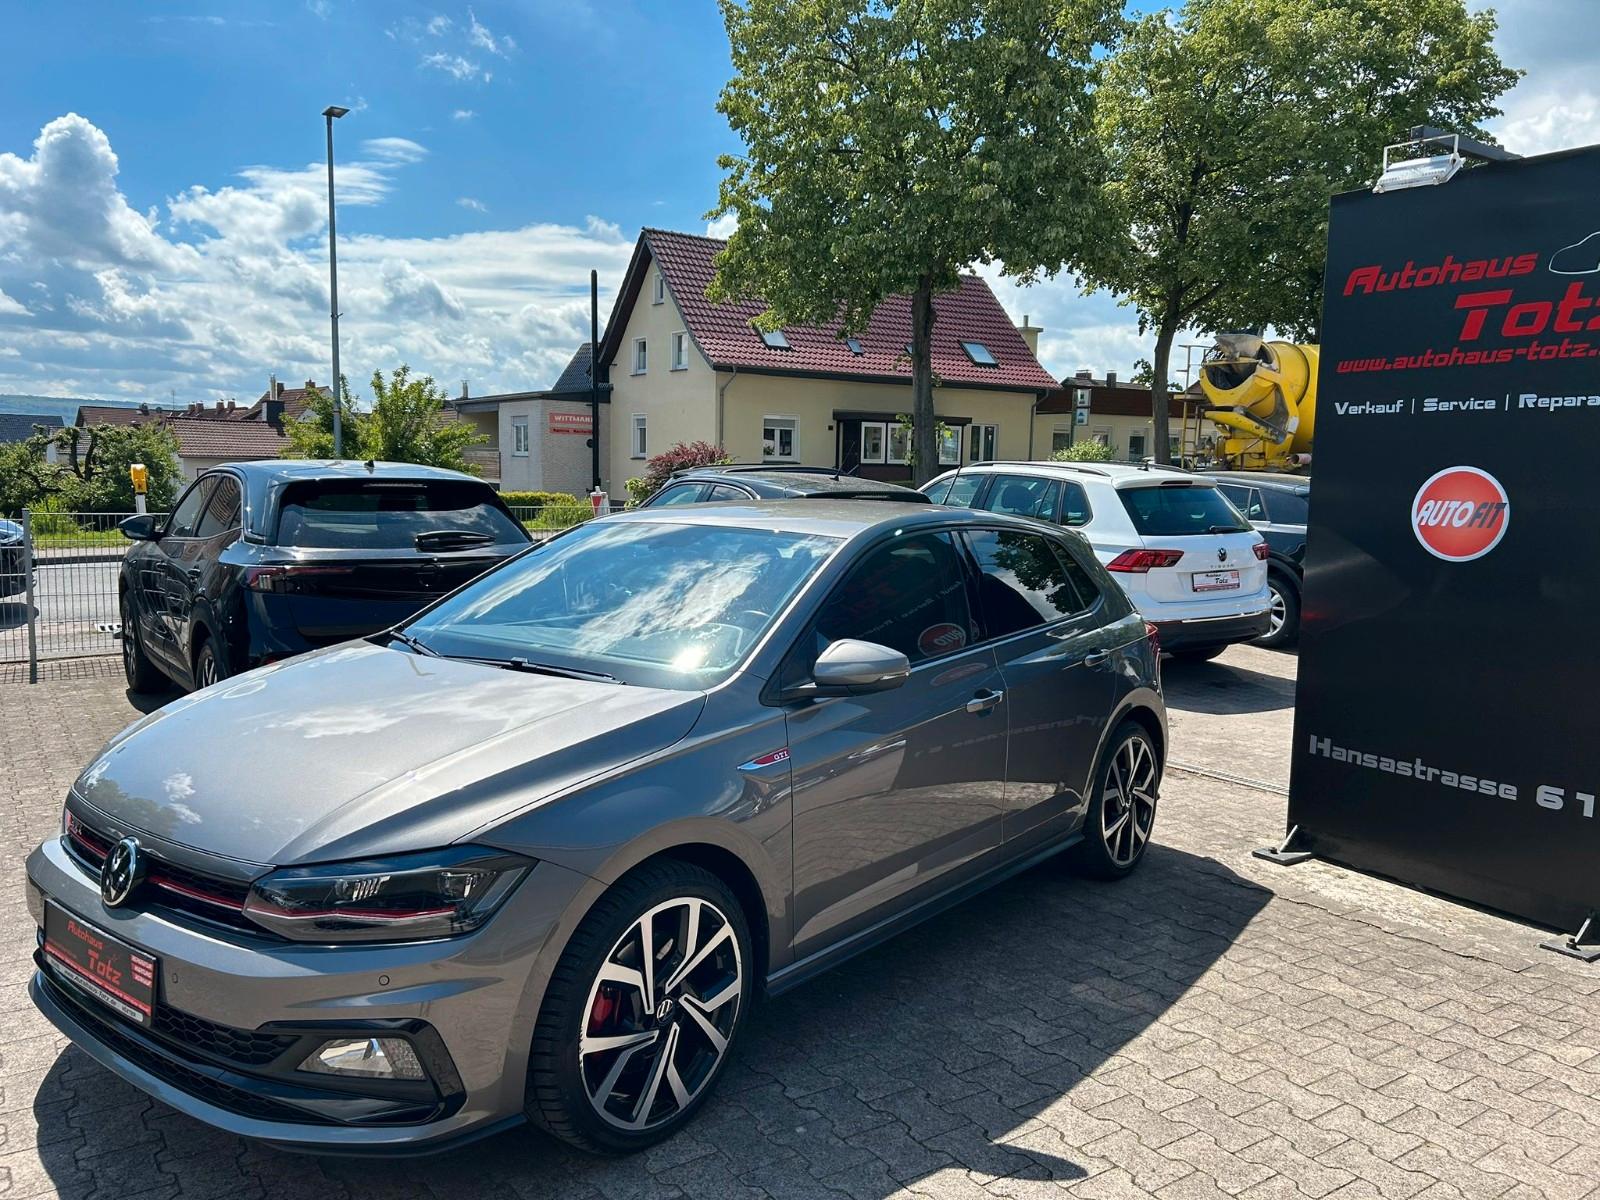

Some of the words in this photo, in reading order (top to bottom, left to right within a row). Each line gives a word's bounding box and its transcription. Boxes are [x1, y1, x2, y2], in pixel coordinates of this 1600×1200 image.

[1343, 253, 1539, 296] Autohaus
[1337, 338, 1600, 373] www.autohaus-totz.
[554, 415, 592, 423] WITTMAN
[1335, 400, 1404, 415] Verkauf
[1423, 397, 1496, 412] Service
[1417, 499, 1508, 529] AUTOFIT
[773, 750, 788, 761] GTI
[1309, 734, 1518, 801] Hansastrasse
[67, 919, 105, 951] Autohaus
[87, 948, 123, 985] Totz
